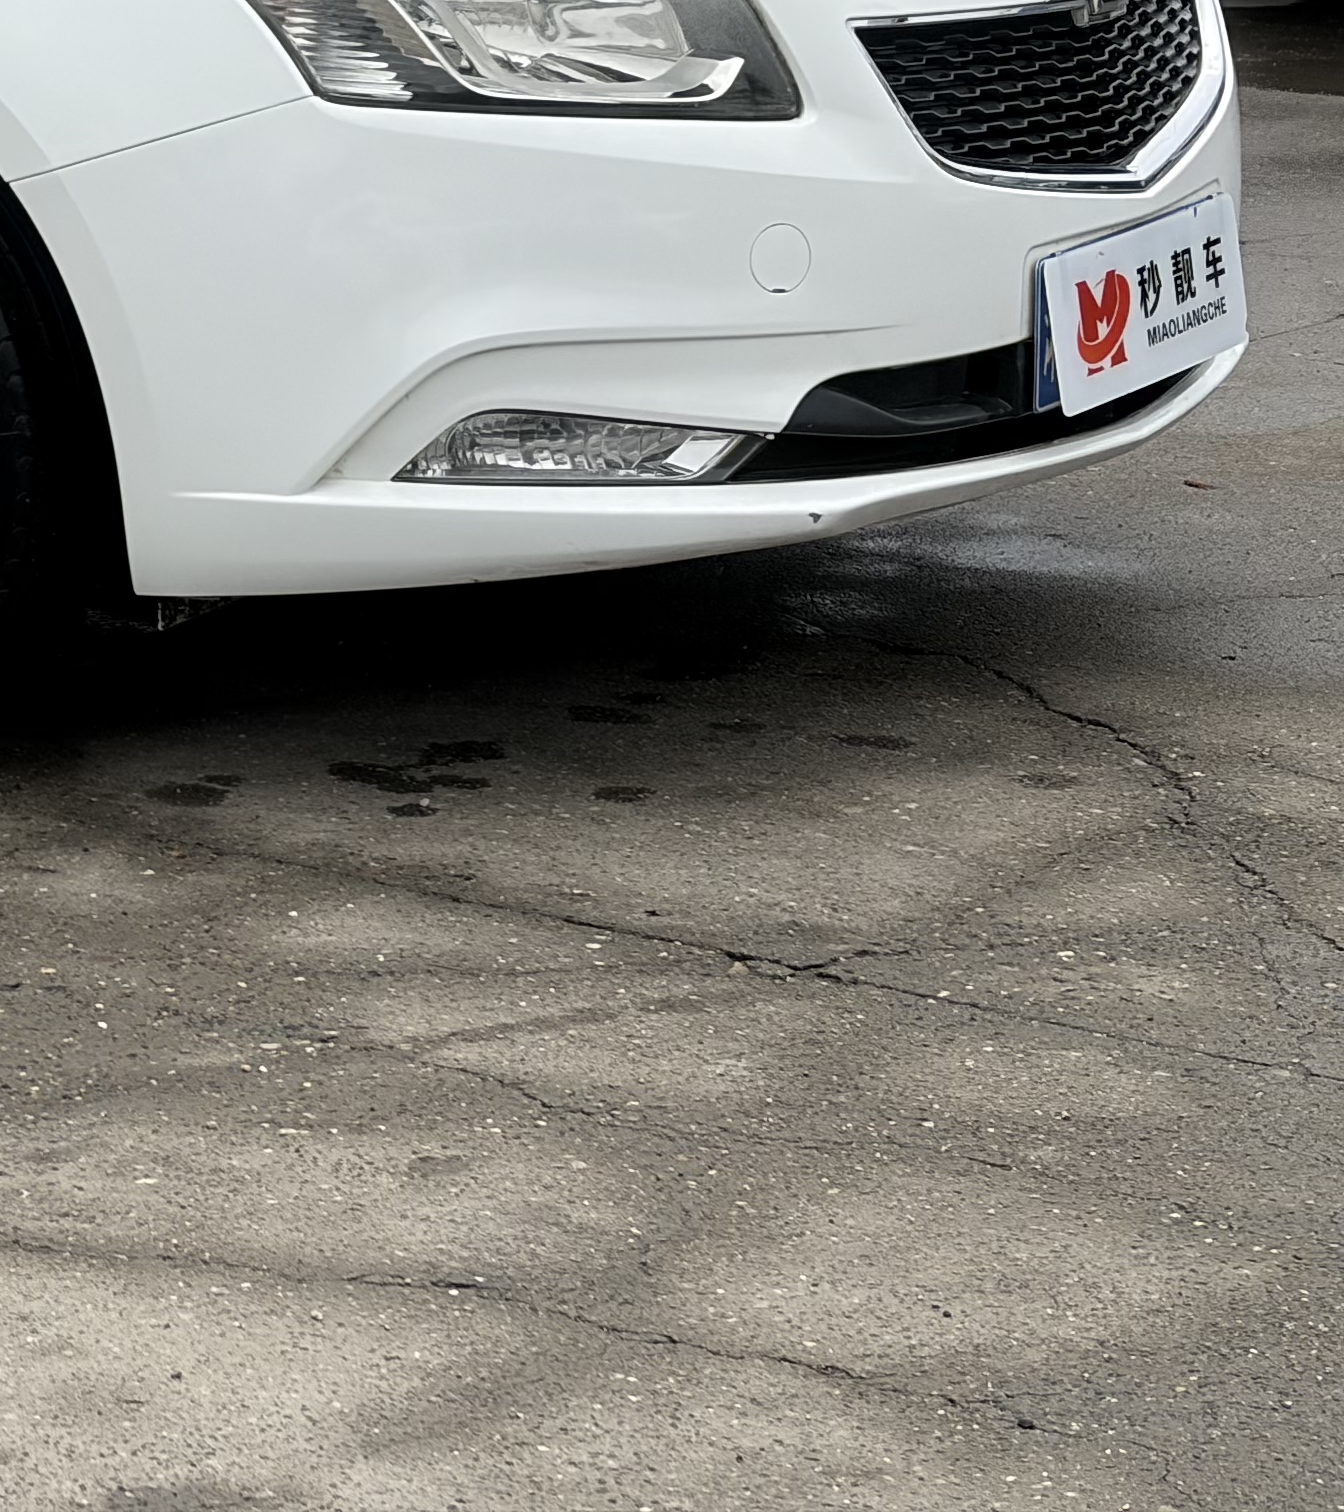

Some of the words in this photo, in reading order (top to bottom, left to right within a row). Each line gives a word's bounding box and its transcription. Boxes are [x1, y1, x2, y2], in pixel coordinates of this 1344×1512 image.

[1136, 236, 1226, 319] 秒靓车
[1146, 296, 1228, 348] MIAOLIANGCHE
